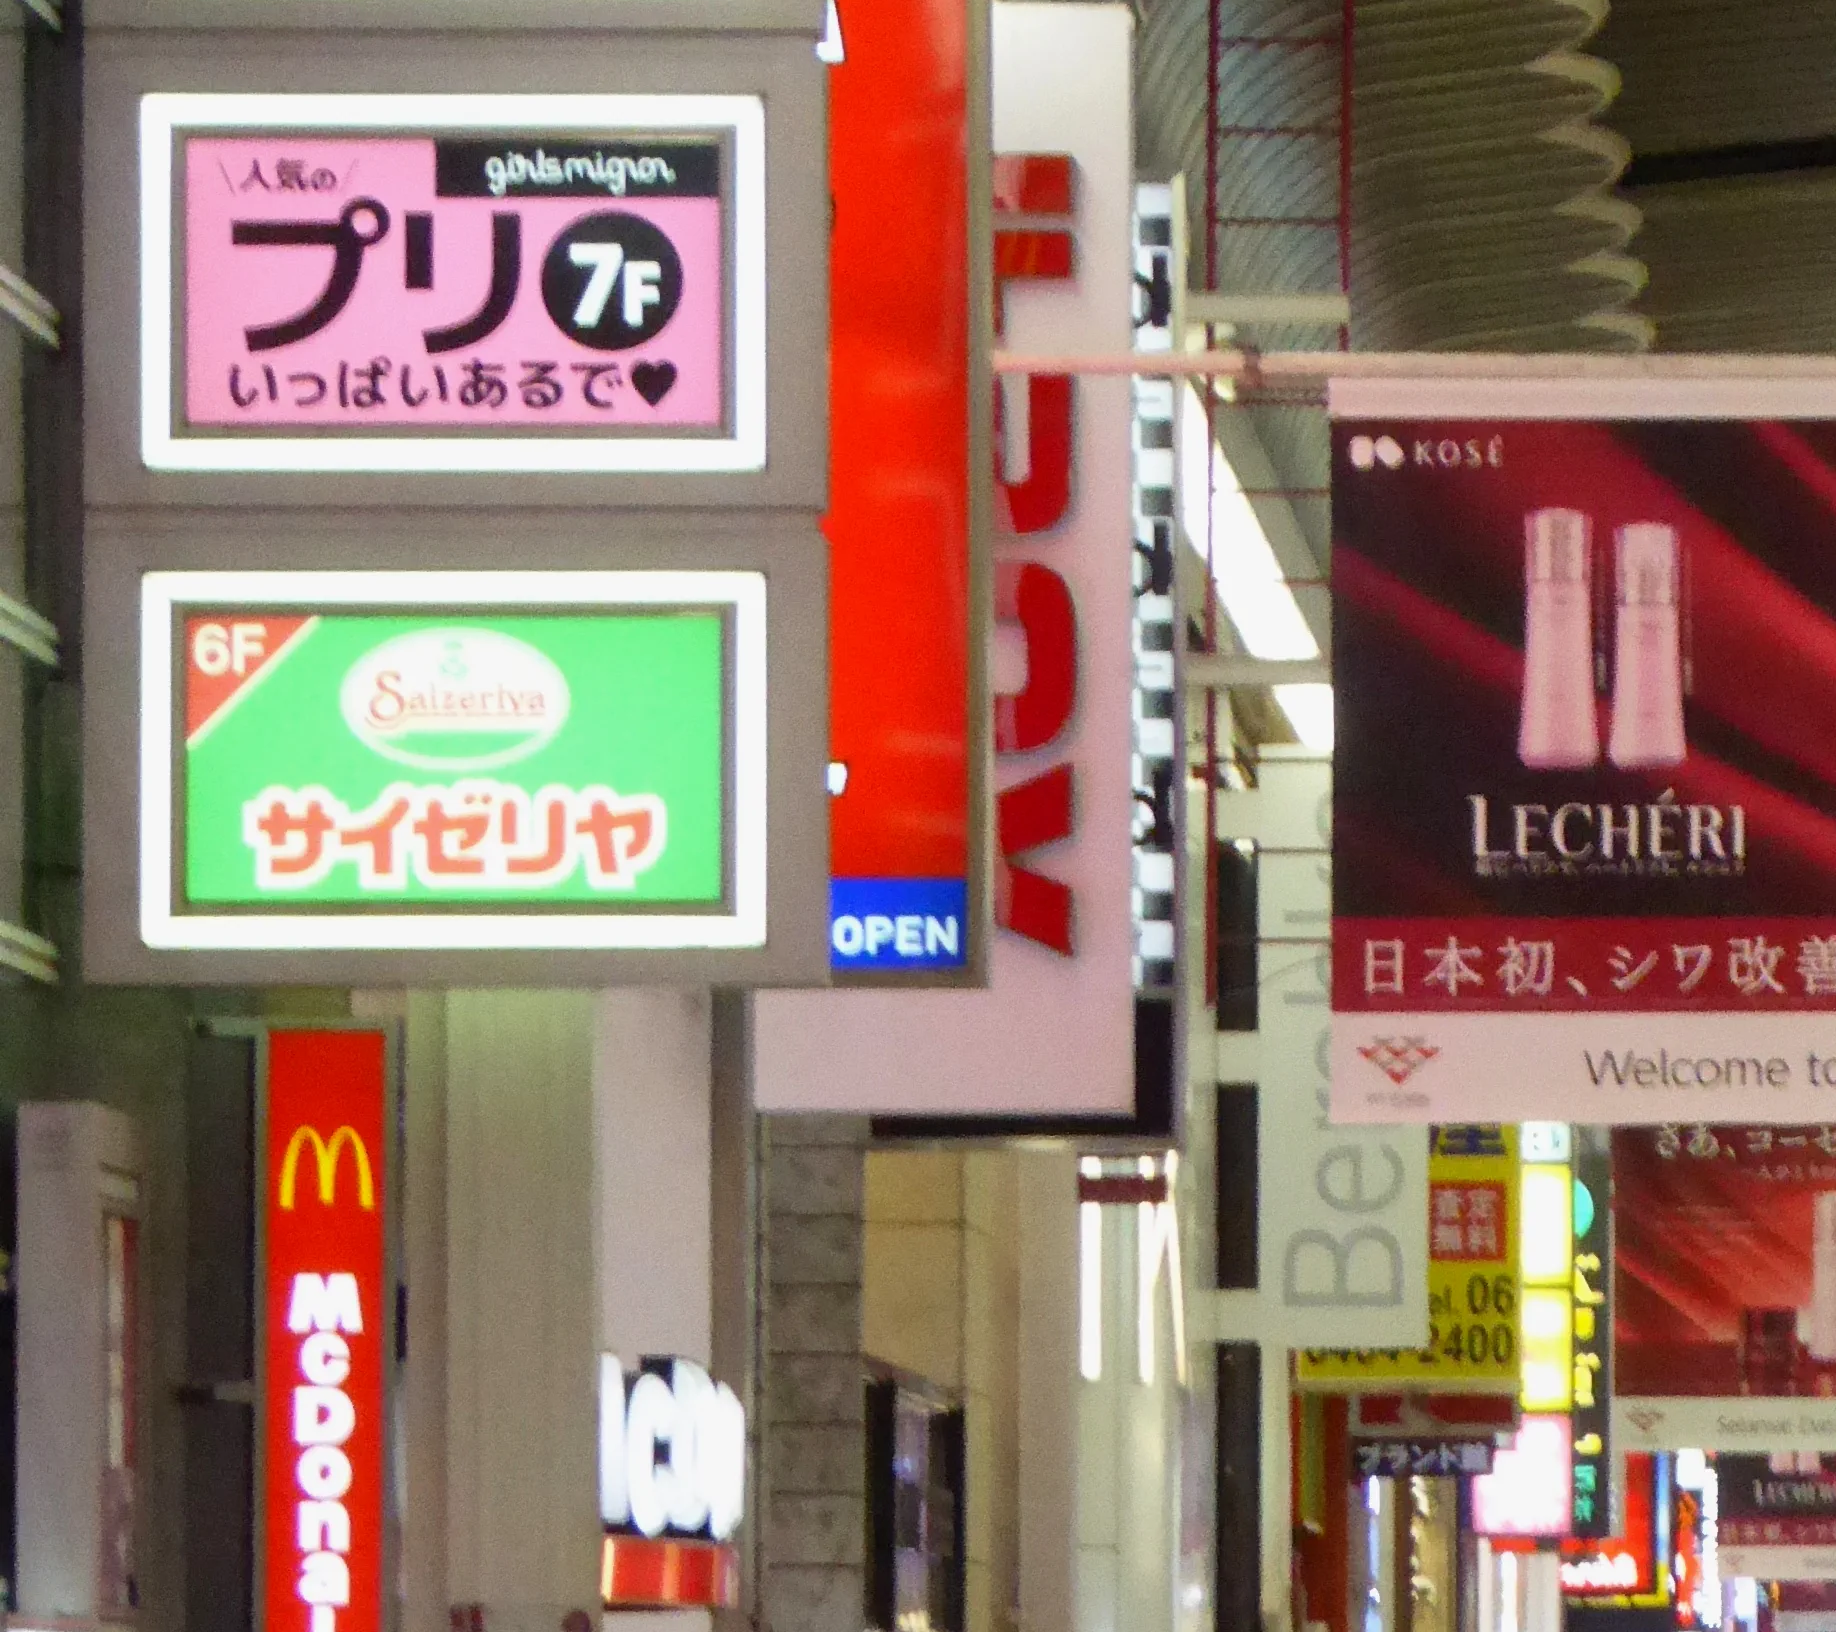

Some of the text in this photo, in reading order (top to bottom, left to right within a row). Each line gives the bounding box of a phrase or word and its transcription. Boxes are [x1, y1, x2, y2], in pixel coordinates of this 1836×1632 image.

[238, 157, 338, 193] 人気の
[231, 196, 523, 354] プリ
[568, 242, 662, 329] 7F
[192, 622, 268, 677] 6F
[251, 788, 660, 881] サイゼリヤ
[1465, 787, 1746, 860] LECHÉRI
[831, 913, 960, 958] OPEN
[1583, 1048, 1791, 1089] Welcome
[1466, 1272, 1515, 1316] 06
